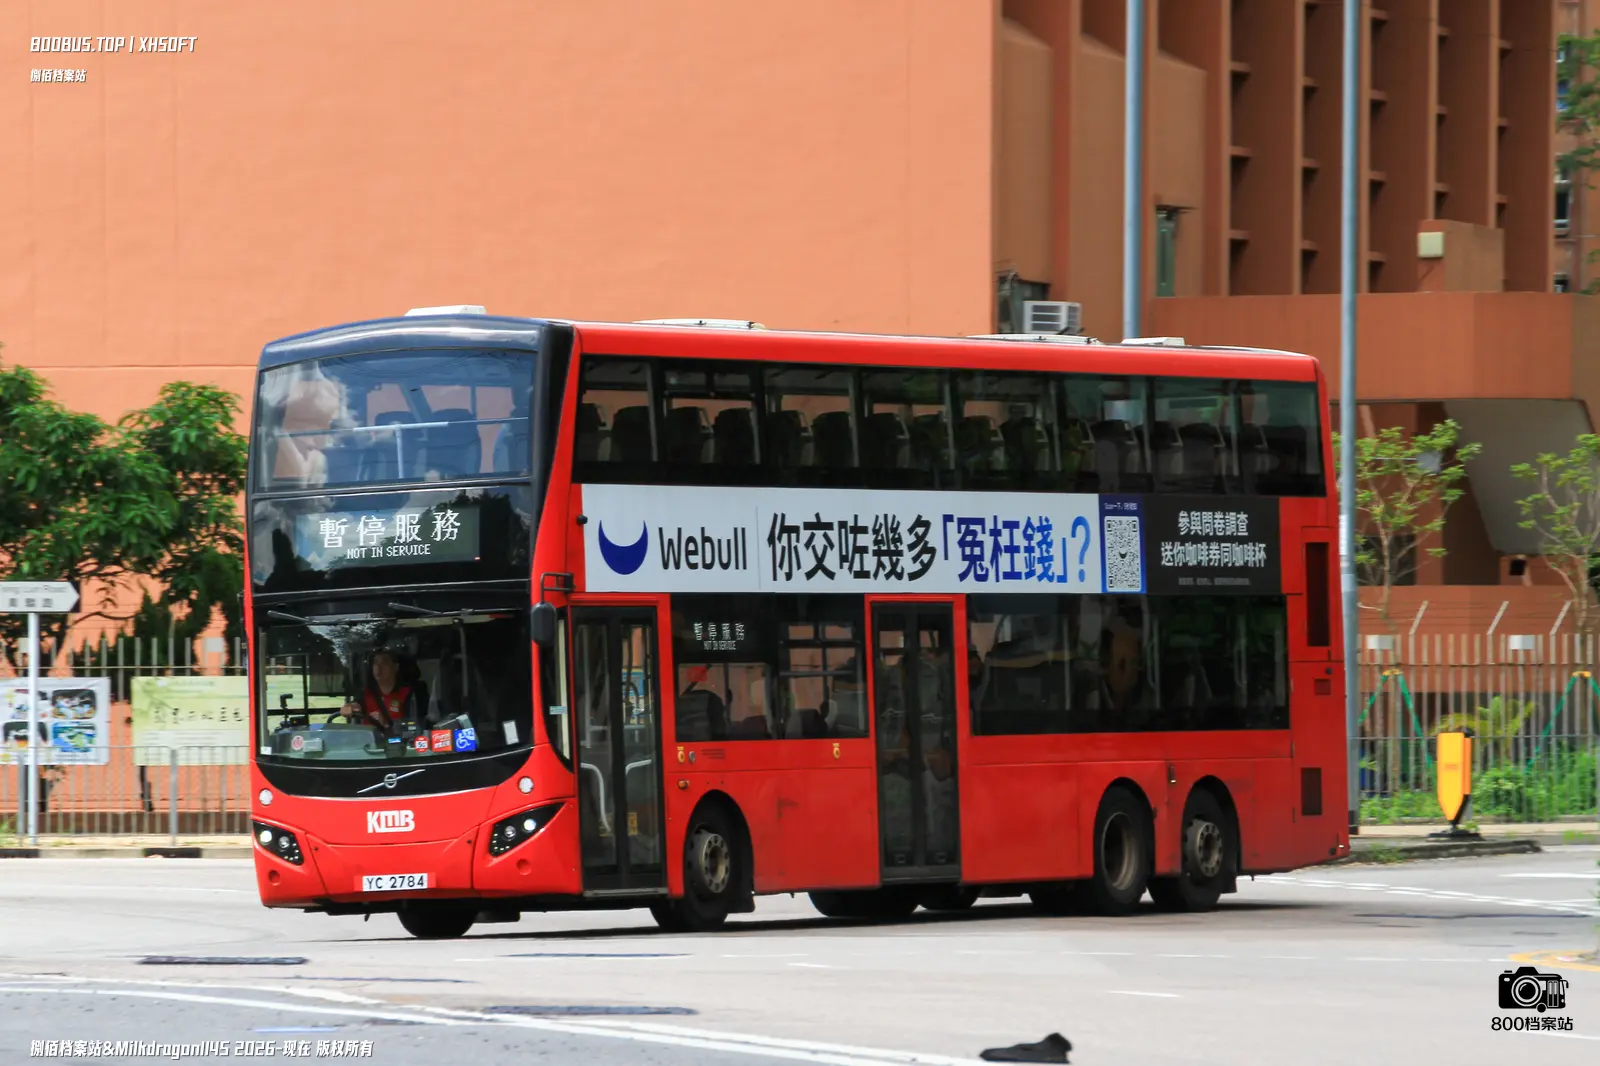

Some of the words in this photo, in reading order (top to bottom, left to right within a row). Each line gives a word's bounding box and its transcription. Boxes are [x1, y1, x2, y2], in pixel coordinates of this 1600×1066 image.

[319, 509, 460, 548] 暫停服務
[1178, 510, 1249, 536] 參與問卷調查
[346, 547, 367, 559] NOT
[371, 547, 383, 558] IN
[386, 544, 431, 557] SERVICE
[658, 526, 748, 571] Webull
[1160, 541, 1267, 568] 送你咖啡券同咖啡杯
[366, 810, 415, 833] KMB
[366, 878, 383, 889] YC
[389, 875, 424, 889] 2784
